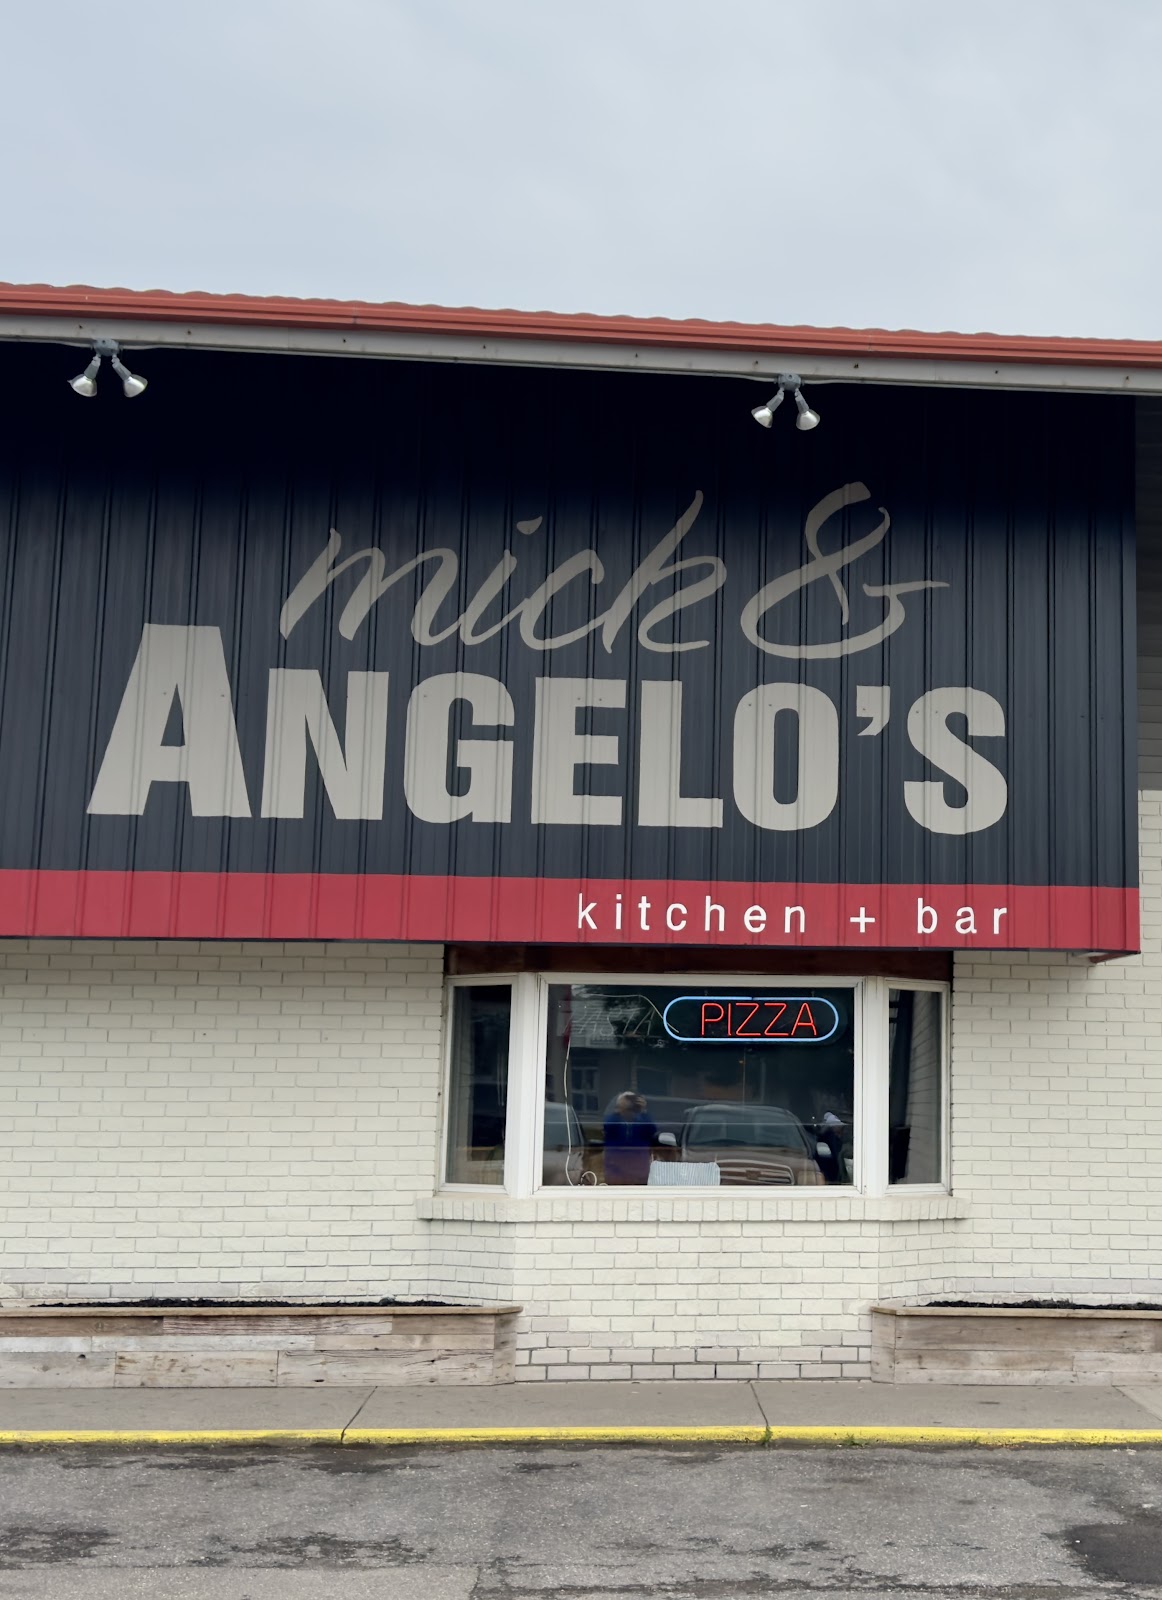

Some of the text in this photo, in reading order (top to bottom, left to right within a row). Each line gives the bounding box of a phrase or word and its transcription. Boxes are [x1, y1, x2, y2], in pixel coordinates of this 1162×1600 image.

[280, 481, 950, 660] mick &
[86, 622, 1008, 836] ANGELO'S
[577, 893, 1008, 935] kitchen + bar
[701, 1002, 817, 1037] PIZZA
